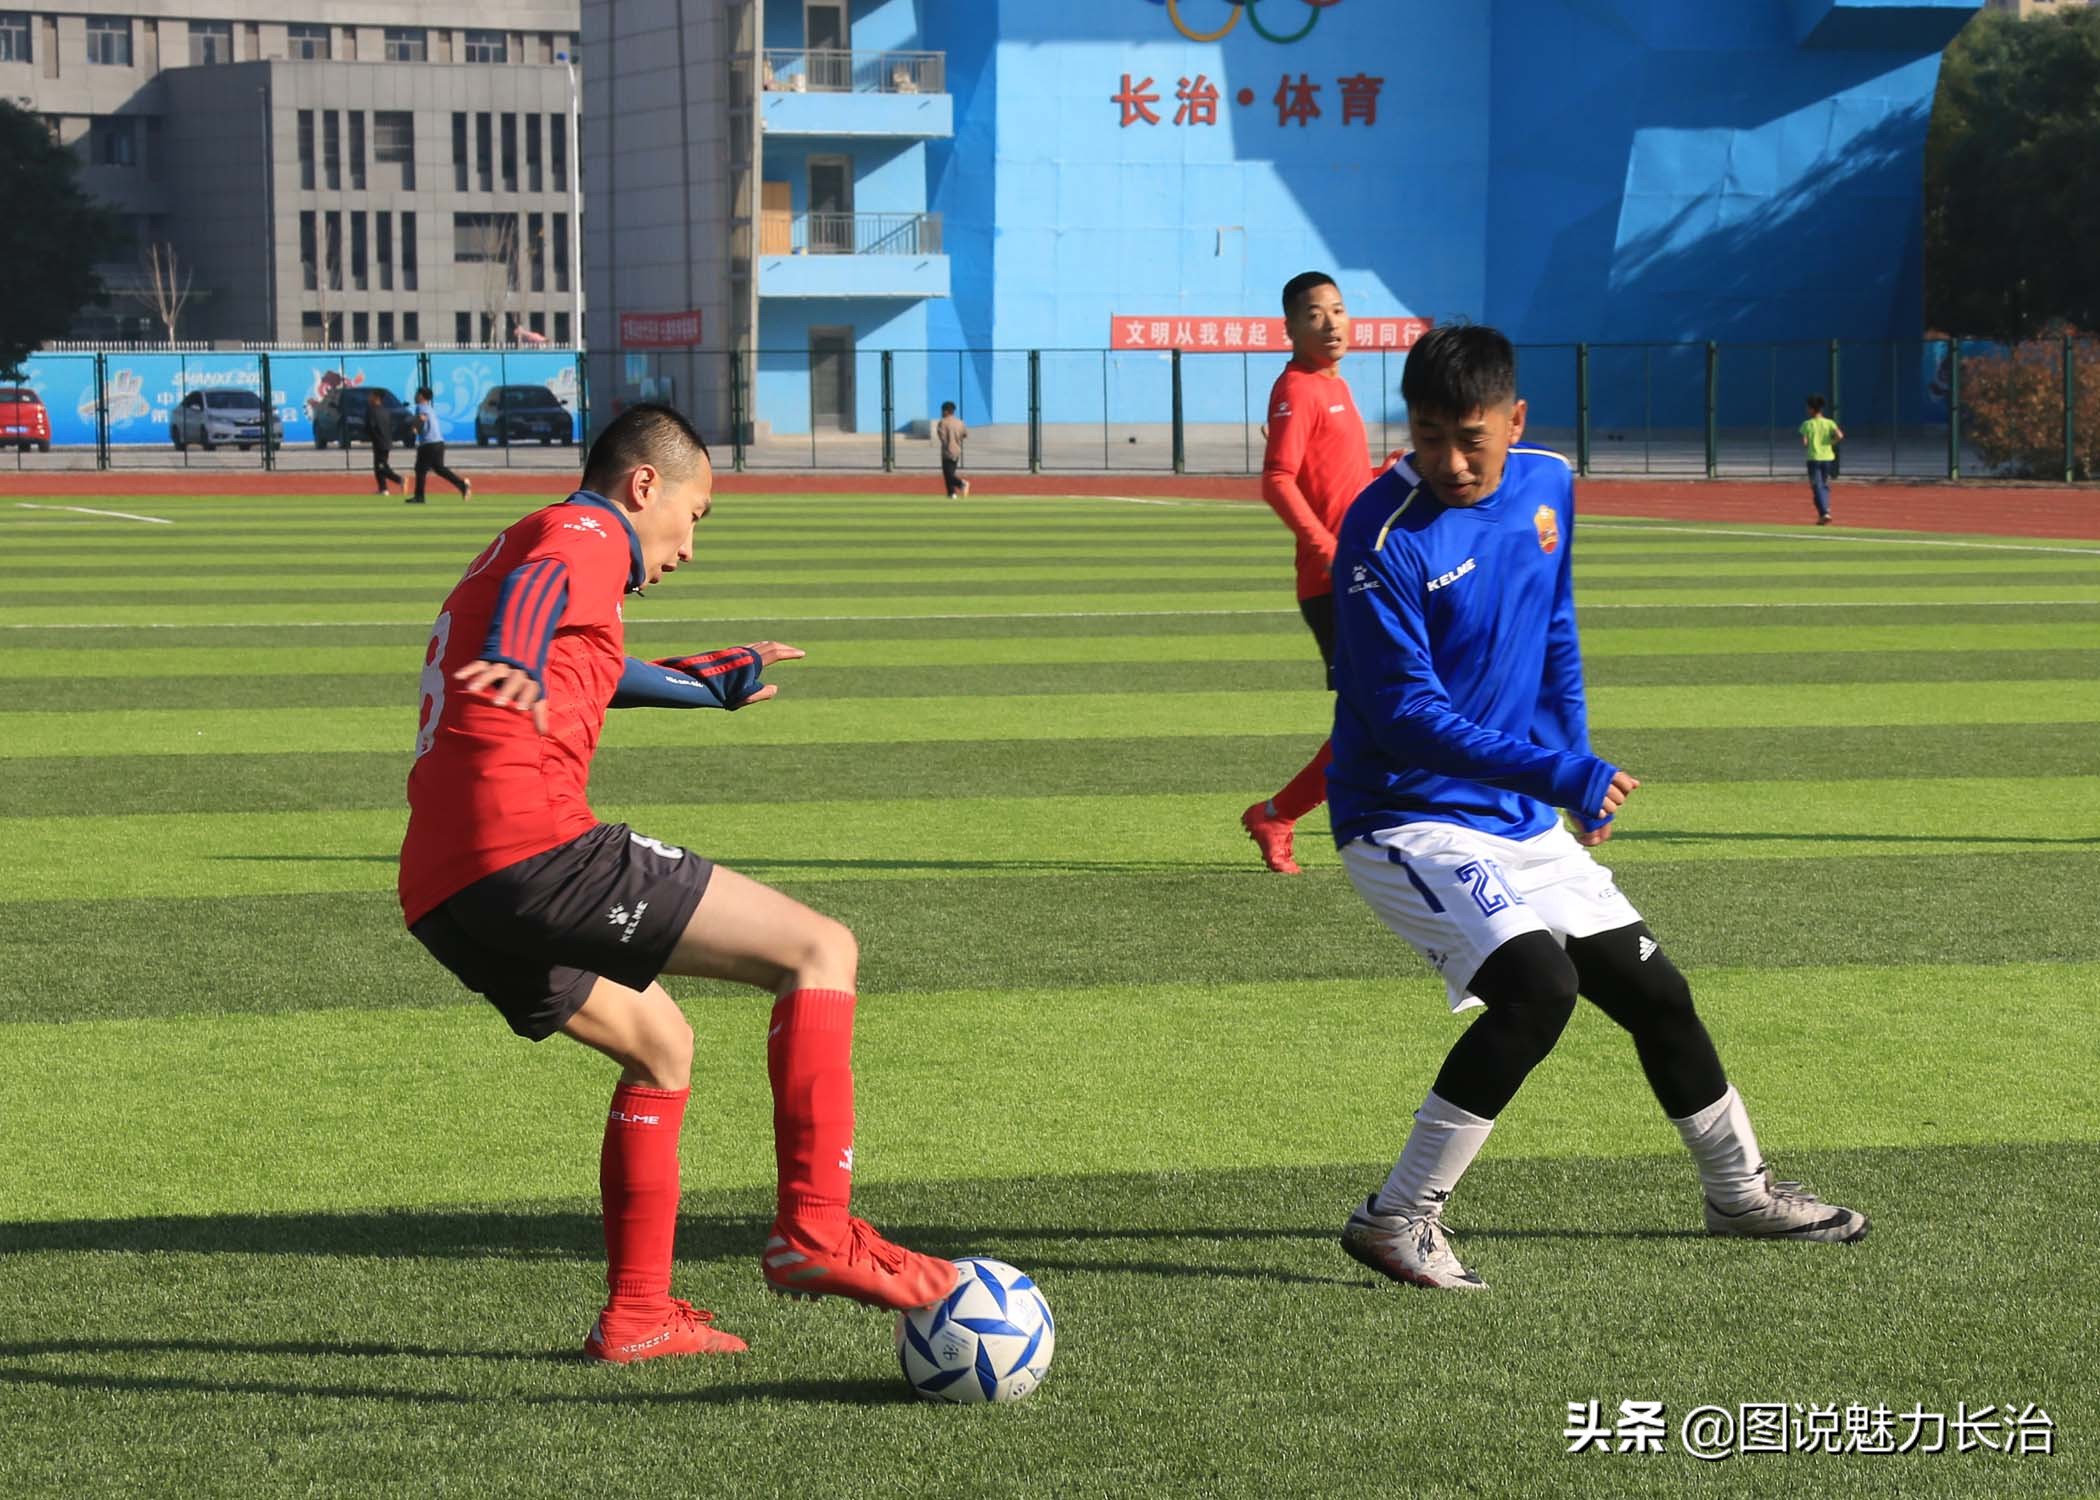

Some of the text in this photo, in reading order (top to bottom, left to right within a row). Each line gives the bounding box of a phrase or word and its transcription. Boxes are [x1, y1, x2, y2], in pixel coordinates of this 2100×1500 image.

[1125, 321, 1269, 346] 文明从我做起
[1426, 557, 1477, 593] KELME
[618, 899, 649, 944] KELME
[609, 1110, 661, 1126] ELME
